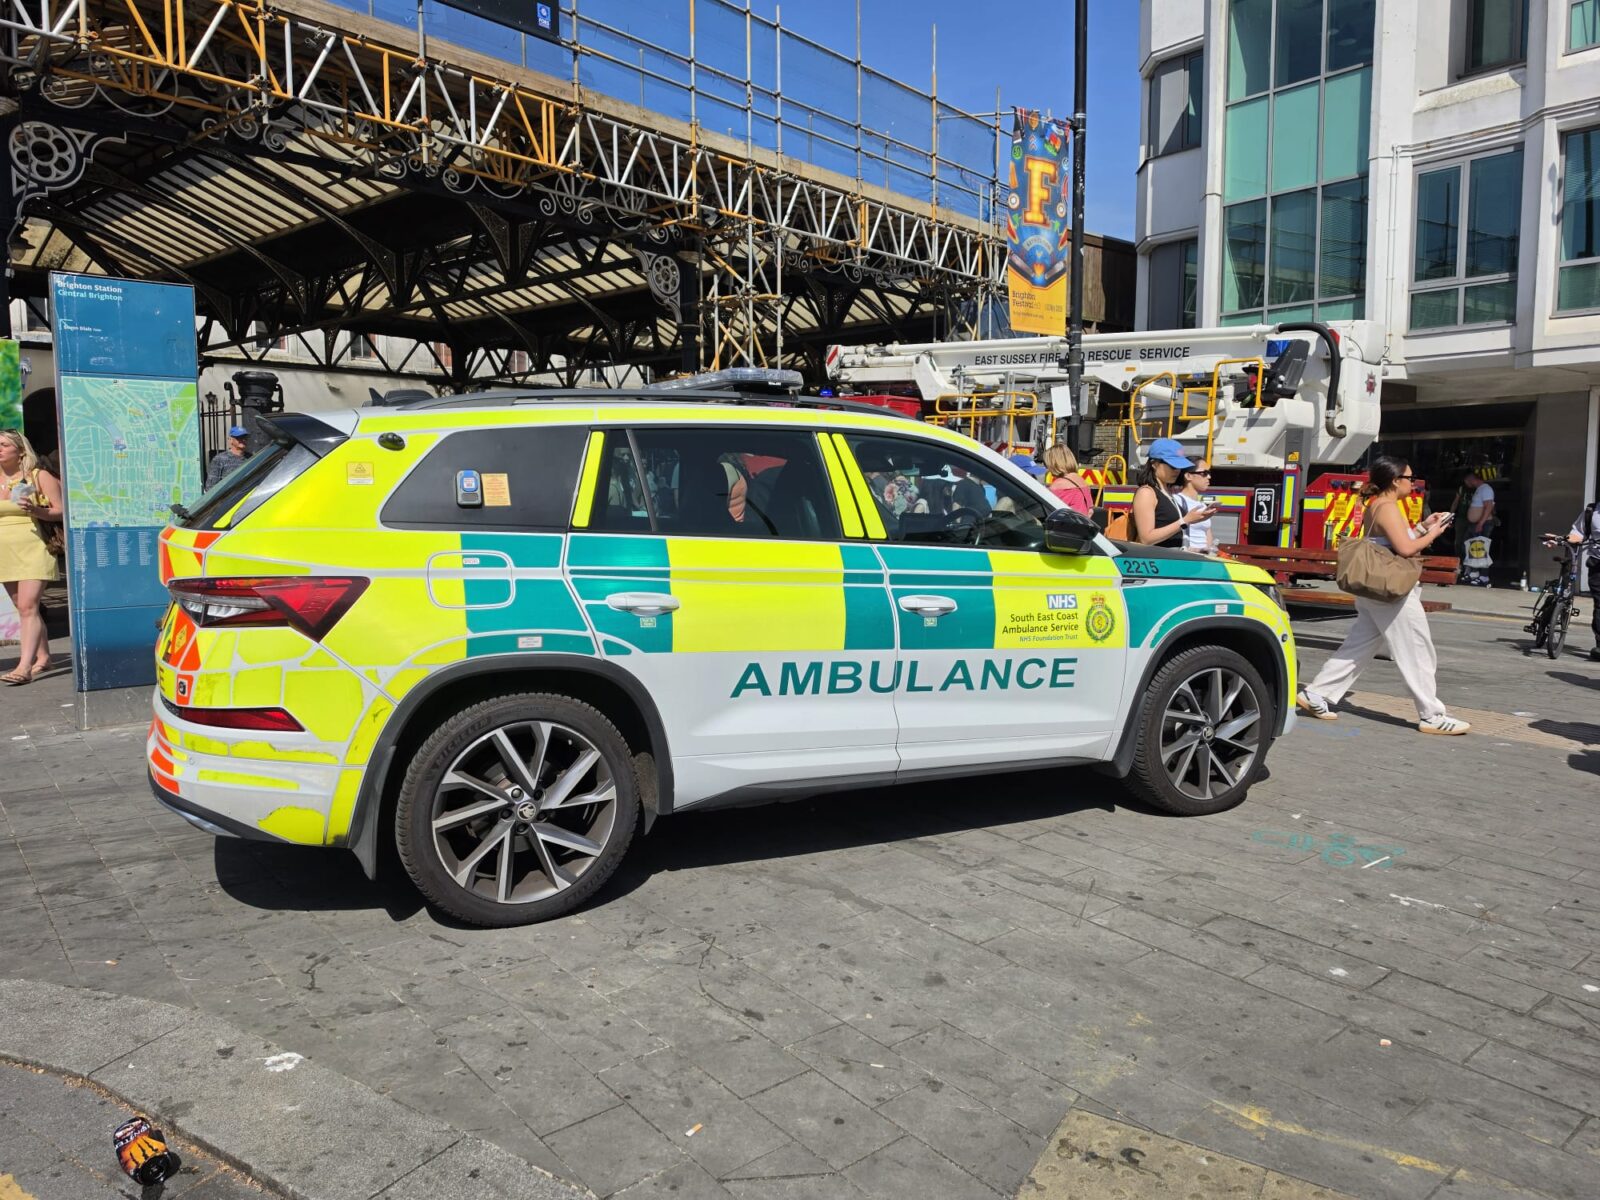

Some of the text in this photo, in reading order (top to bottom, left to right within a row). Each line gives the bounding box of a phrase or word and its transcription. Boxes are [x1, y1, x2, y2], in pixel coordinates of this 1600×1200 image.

[1023, 155, 1058, 228] F
[57, 280, 122, 293] Brighton Station
[57, 289, 123, 301] Central Brighton
[974, 355, 999, 366] EAST
[999, 353, 1037, 365] SUSSEX
[1039, 352, 1061, 363] FIRE
[1088, 349, 1132, 361] RESCUE
[1139, 346, 1190, 359] SERVICE
[1123, 560, 1159, 574] 2215
[1047, 594, 1077, 609] NHS
[1010, 612, 1079, 623] South East Coast
[1002, 622, 1079, 634] Ambulance Service
[730, 658, 1078, 698] AMBULANCE
